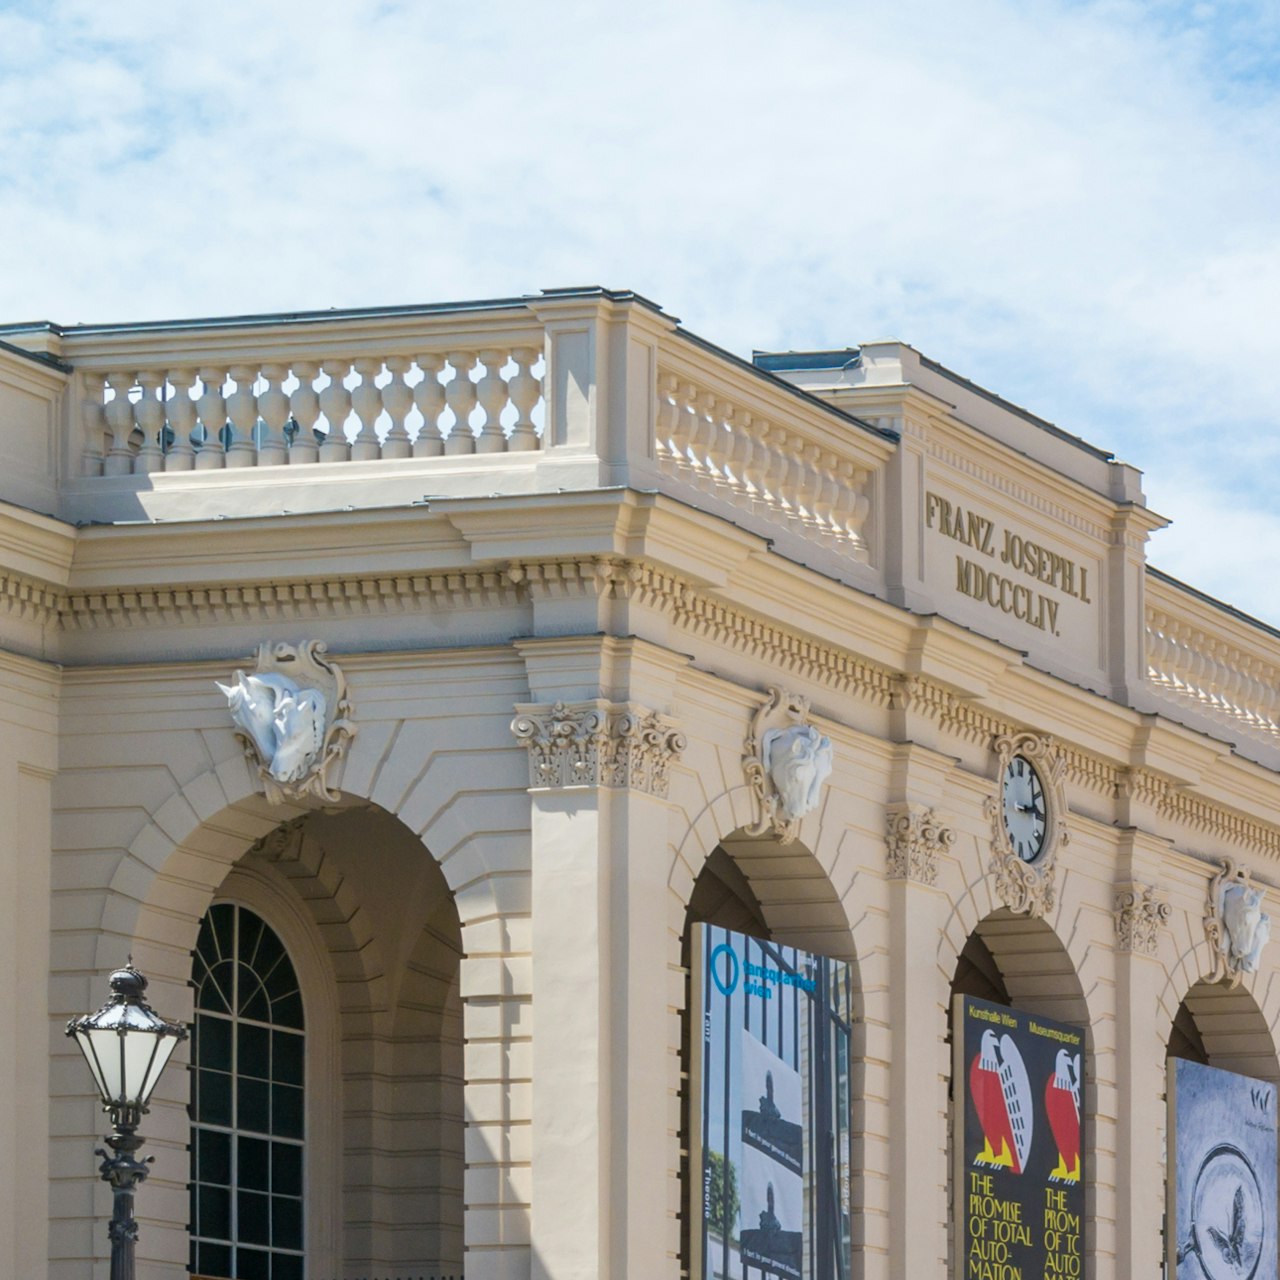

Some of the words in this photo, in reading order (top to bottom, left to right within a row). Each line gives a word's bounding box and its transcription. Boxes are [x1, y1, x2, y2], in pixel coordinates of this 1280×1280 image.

[926, 490, 995, 558] FRANZ
[956, 555, 1060, 637] MDCCCLIV.
[743, 959, 817, 992] tanzquartier
[743, 979, 772, 999] wien
[968, 1005, 1000, 1024] Kunsthalle
[1001, 1013, 1018, 1028] Wien
[1029, 1021, 1080, 1046] Museumsquartier
[704, 1167, 712, 1219] Theorie
[970, 1172, 994, 1196] THE
[970, 1194, 1022, 1223] PROMISE
[1045, 1188, 1068, 1211] THE
[970, 1216, 989, 1237] OF
[993, 1220, 1033, 1246] TOTAL
[1045, 1208, 1080, 1234] PROM
[970, 1238, 1012, 1263] AUTO-
[1044, 1230, 1062, 1251] OF
[1045, 1251, 1080, 1276] AUTO
